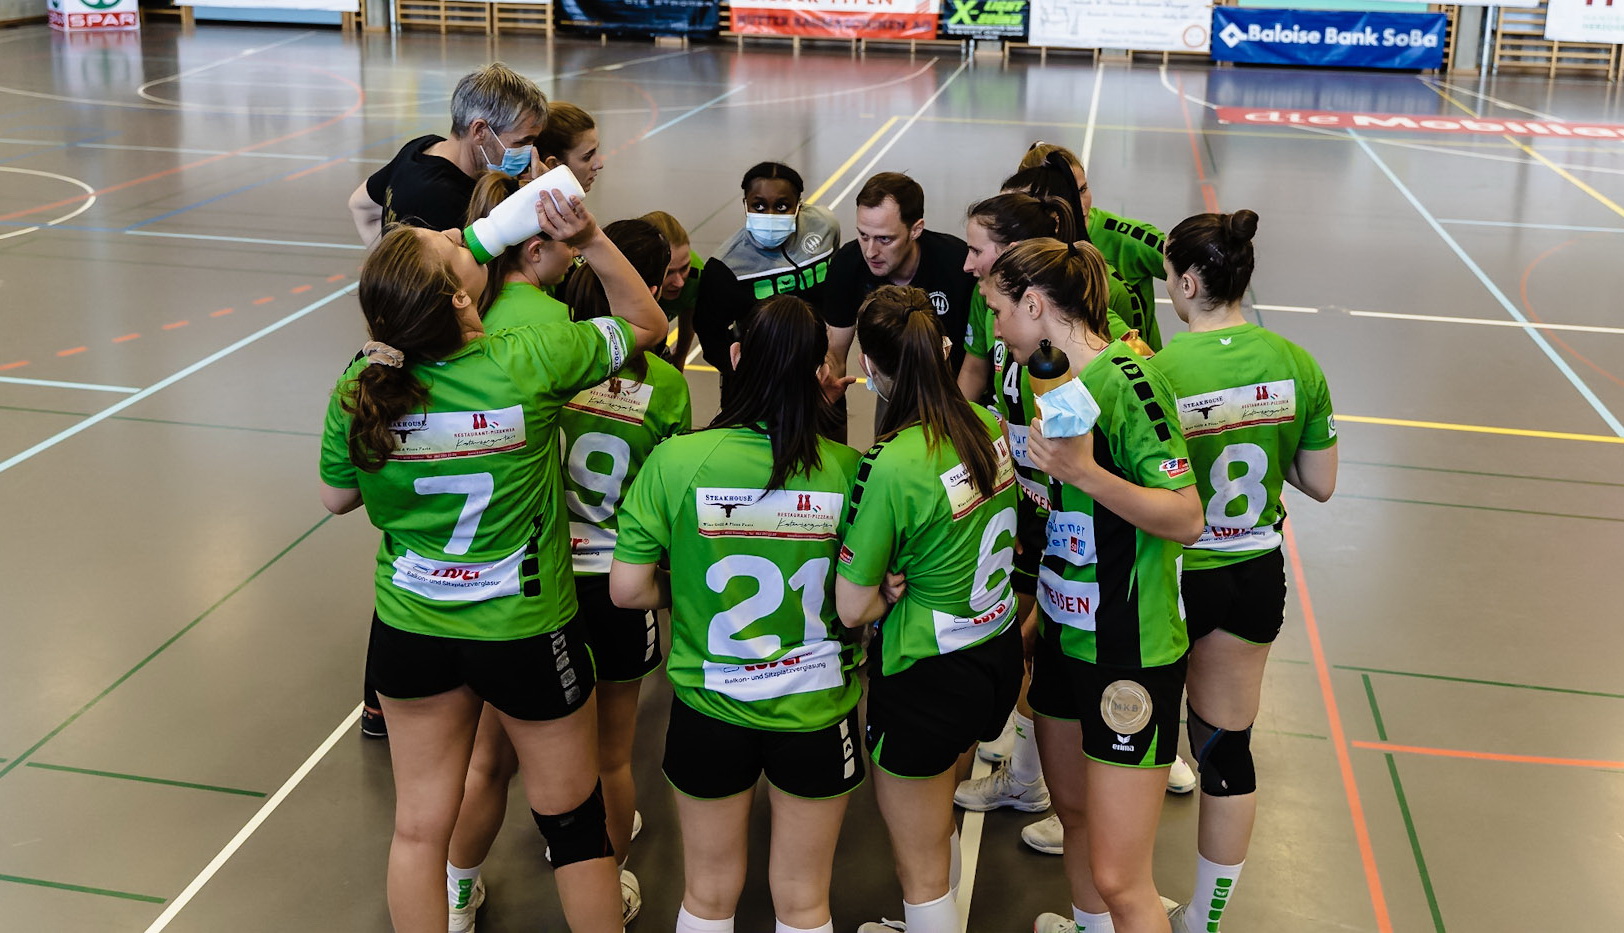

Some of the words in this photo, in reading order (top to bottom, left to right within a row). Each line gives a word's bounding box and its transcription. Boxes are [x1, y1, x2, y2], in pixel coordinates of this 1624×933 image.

[69, 13, 135, 27] SPAR
[1247, 23, 1321, 45] Baloise
[1324, 26, 1379, 47] Bank
[1382, 28, 1438, 48] SoBa
[1352, 115, 1624, 138] Mobilia
[1182, 396, 1223, 409] STEAKHOUSE
[1205, 442, 1269, 529] 8
[705, 494, 753, 502] STEAKHOUSE
[414, 471, 495, 556] 7
[968, 506, 1018, 613] 6
[705, 554, 831, 660] 21
[724, 675, 749, 684] Balkon-
[751, 673, 764, 681] und
[764, 661, 827, 678] Sitzplatzverglasung
[1112, 743, 1135, 752] erima
